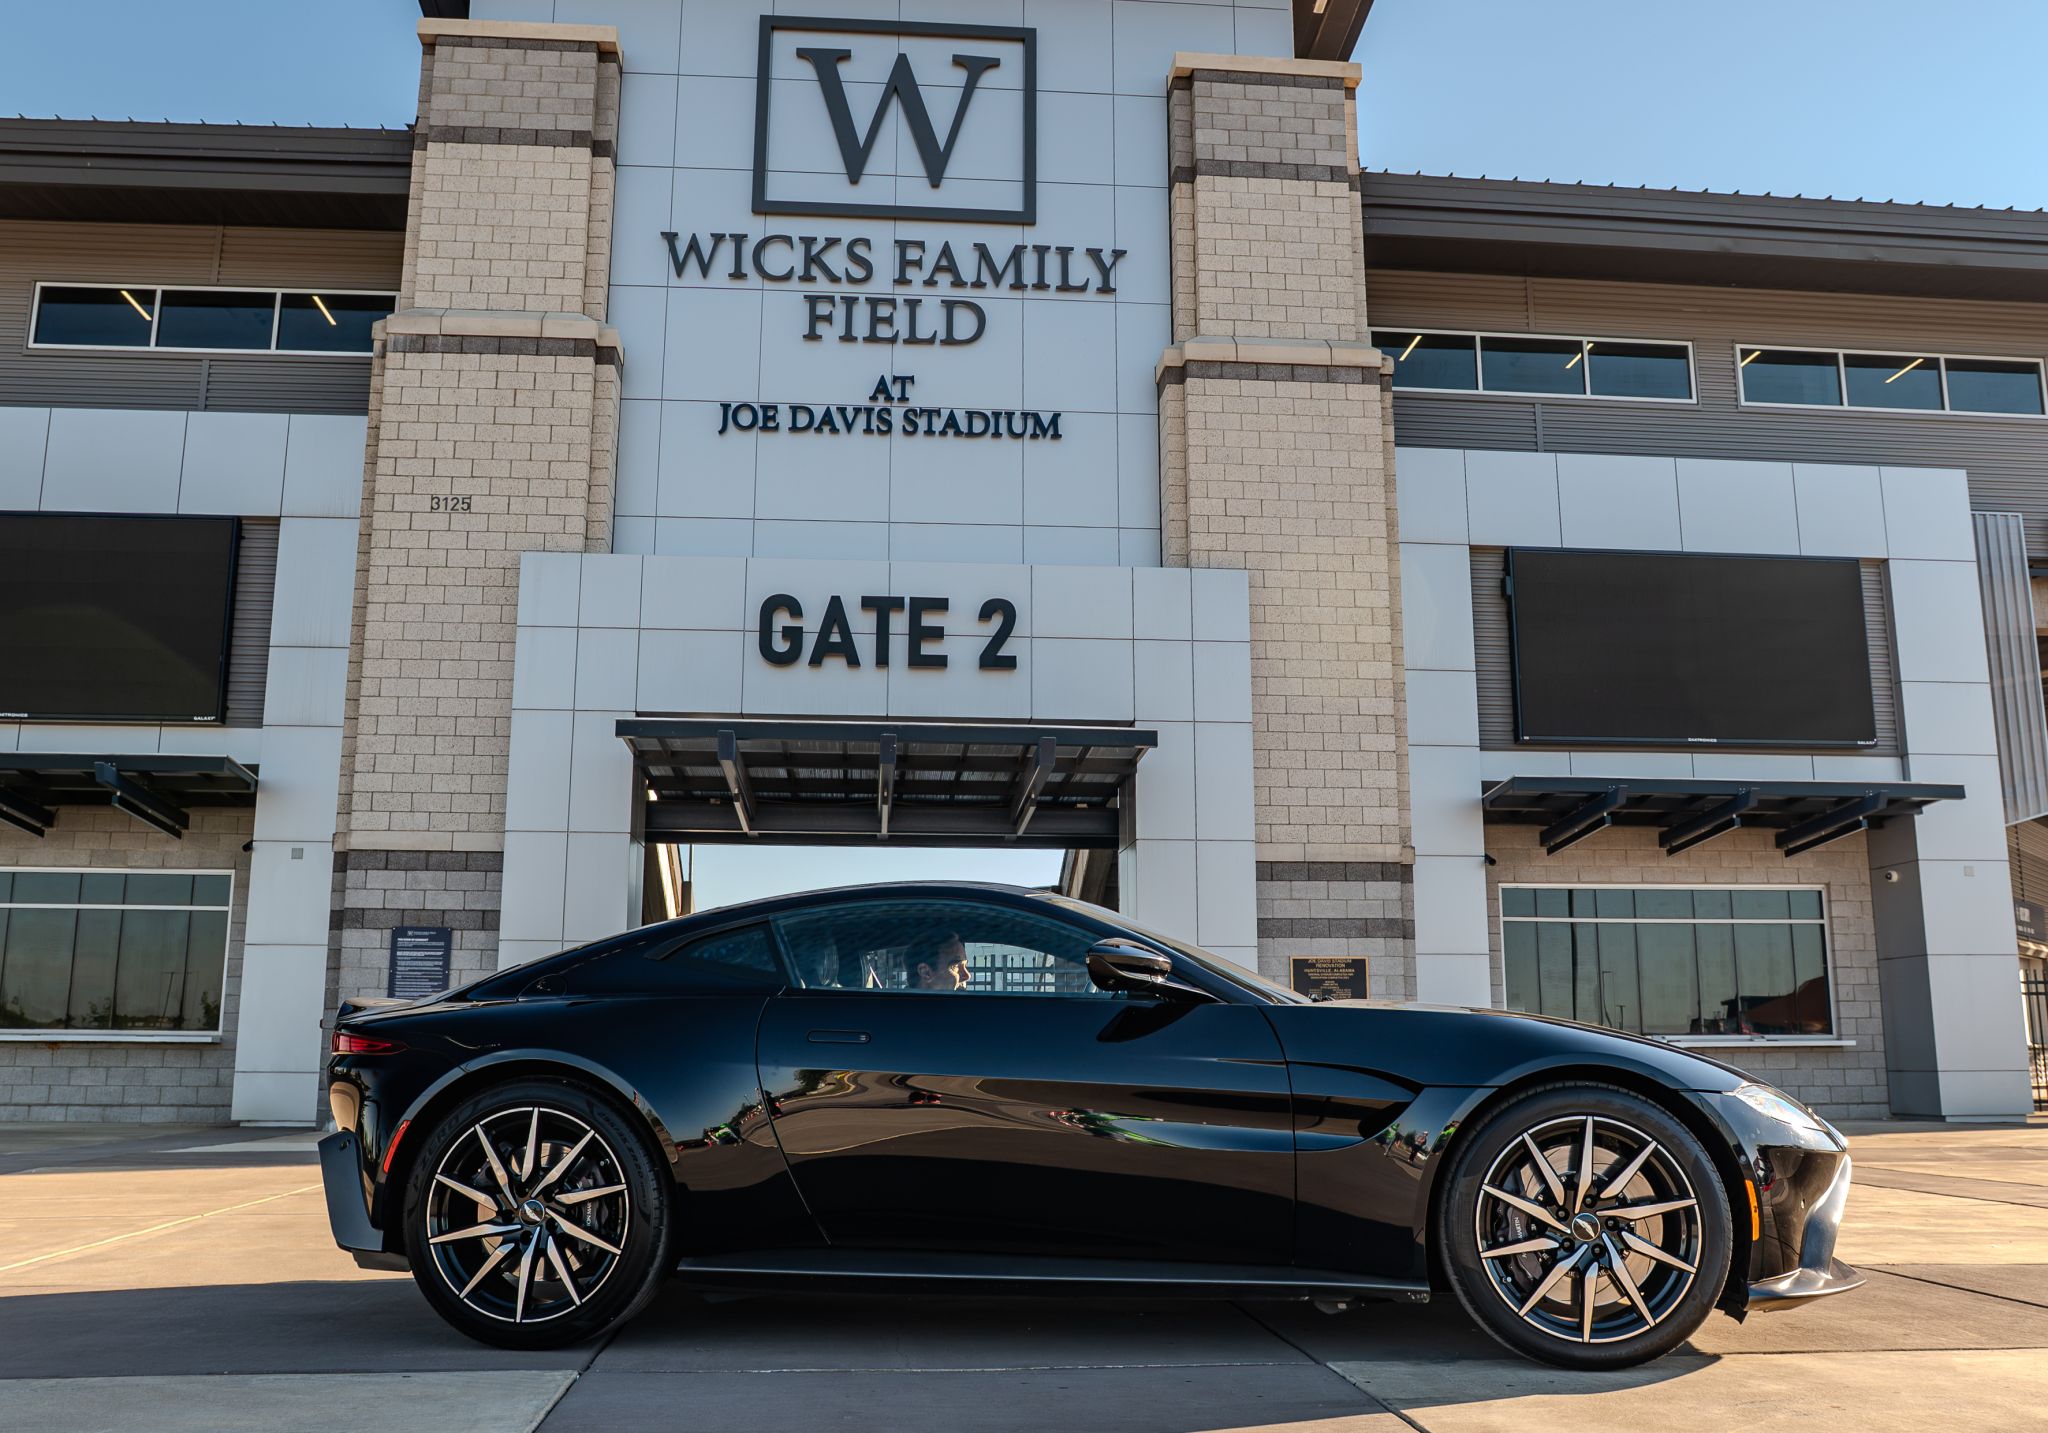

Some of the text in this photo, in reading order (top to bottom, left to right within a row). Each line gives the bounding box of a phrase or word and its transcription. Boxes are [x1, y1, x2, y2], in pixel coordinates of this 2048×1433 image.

[796, 47, 1000, 188] W
[660, 231, 1128, 292] WICKS FAMILY
[802, 294, 987, 346] FIELD
[869, 375, 915, 402] AT
[718, 403, 1063, 440] JOE DAVIS STADIUM
[431, 496, 471, 511] 3125
[758, 593, 1018, 669] GATE 2
